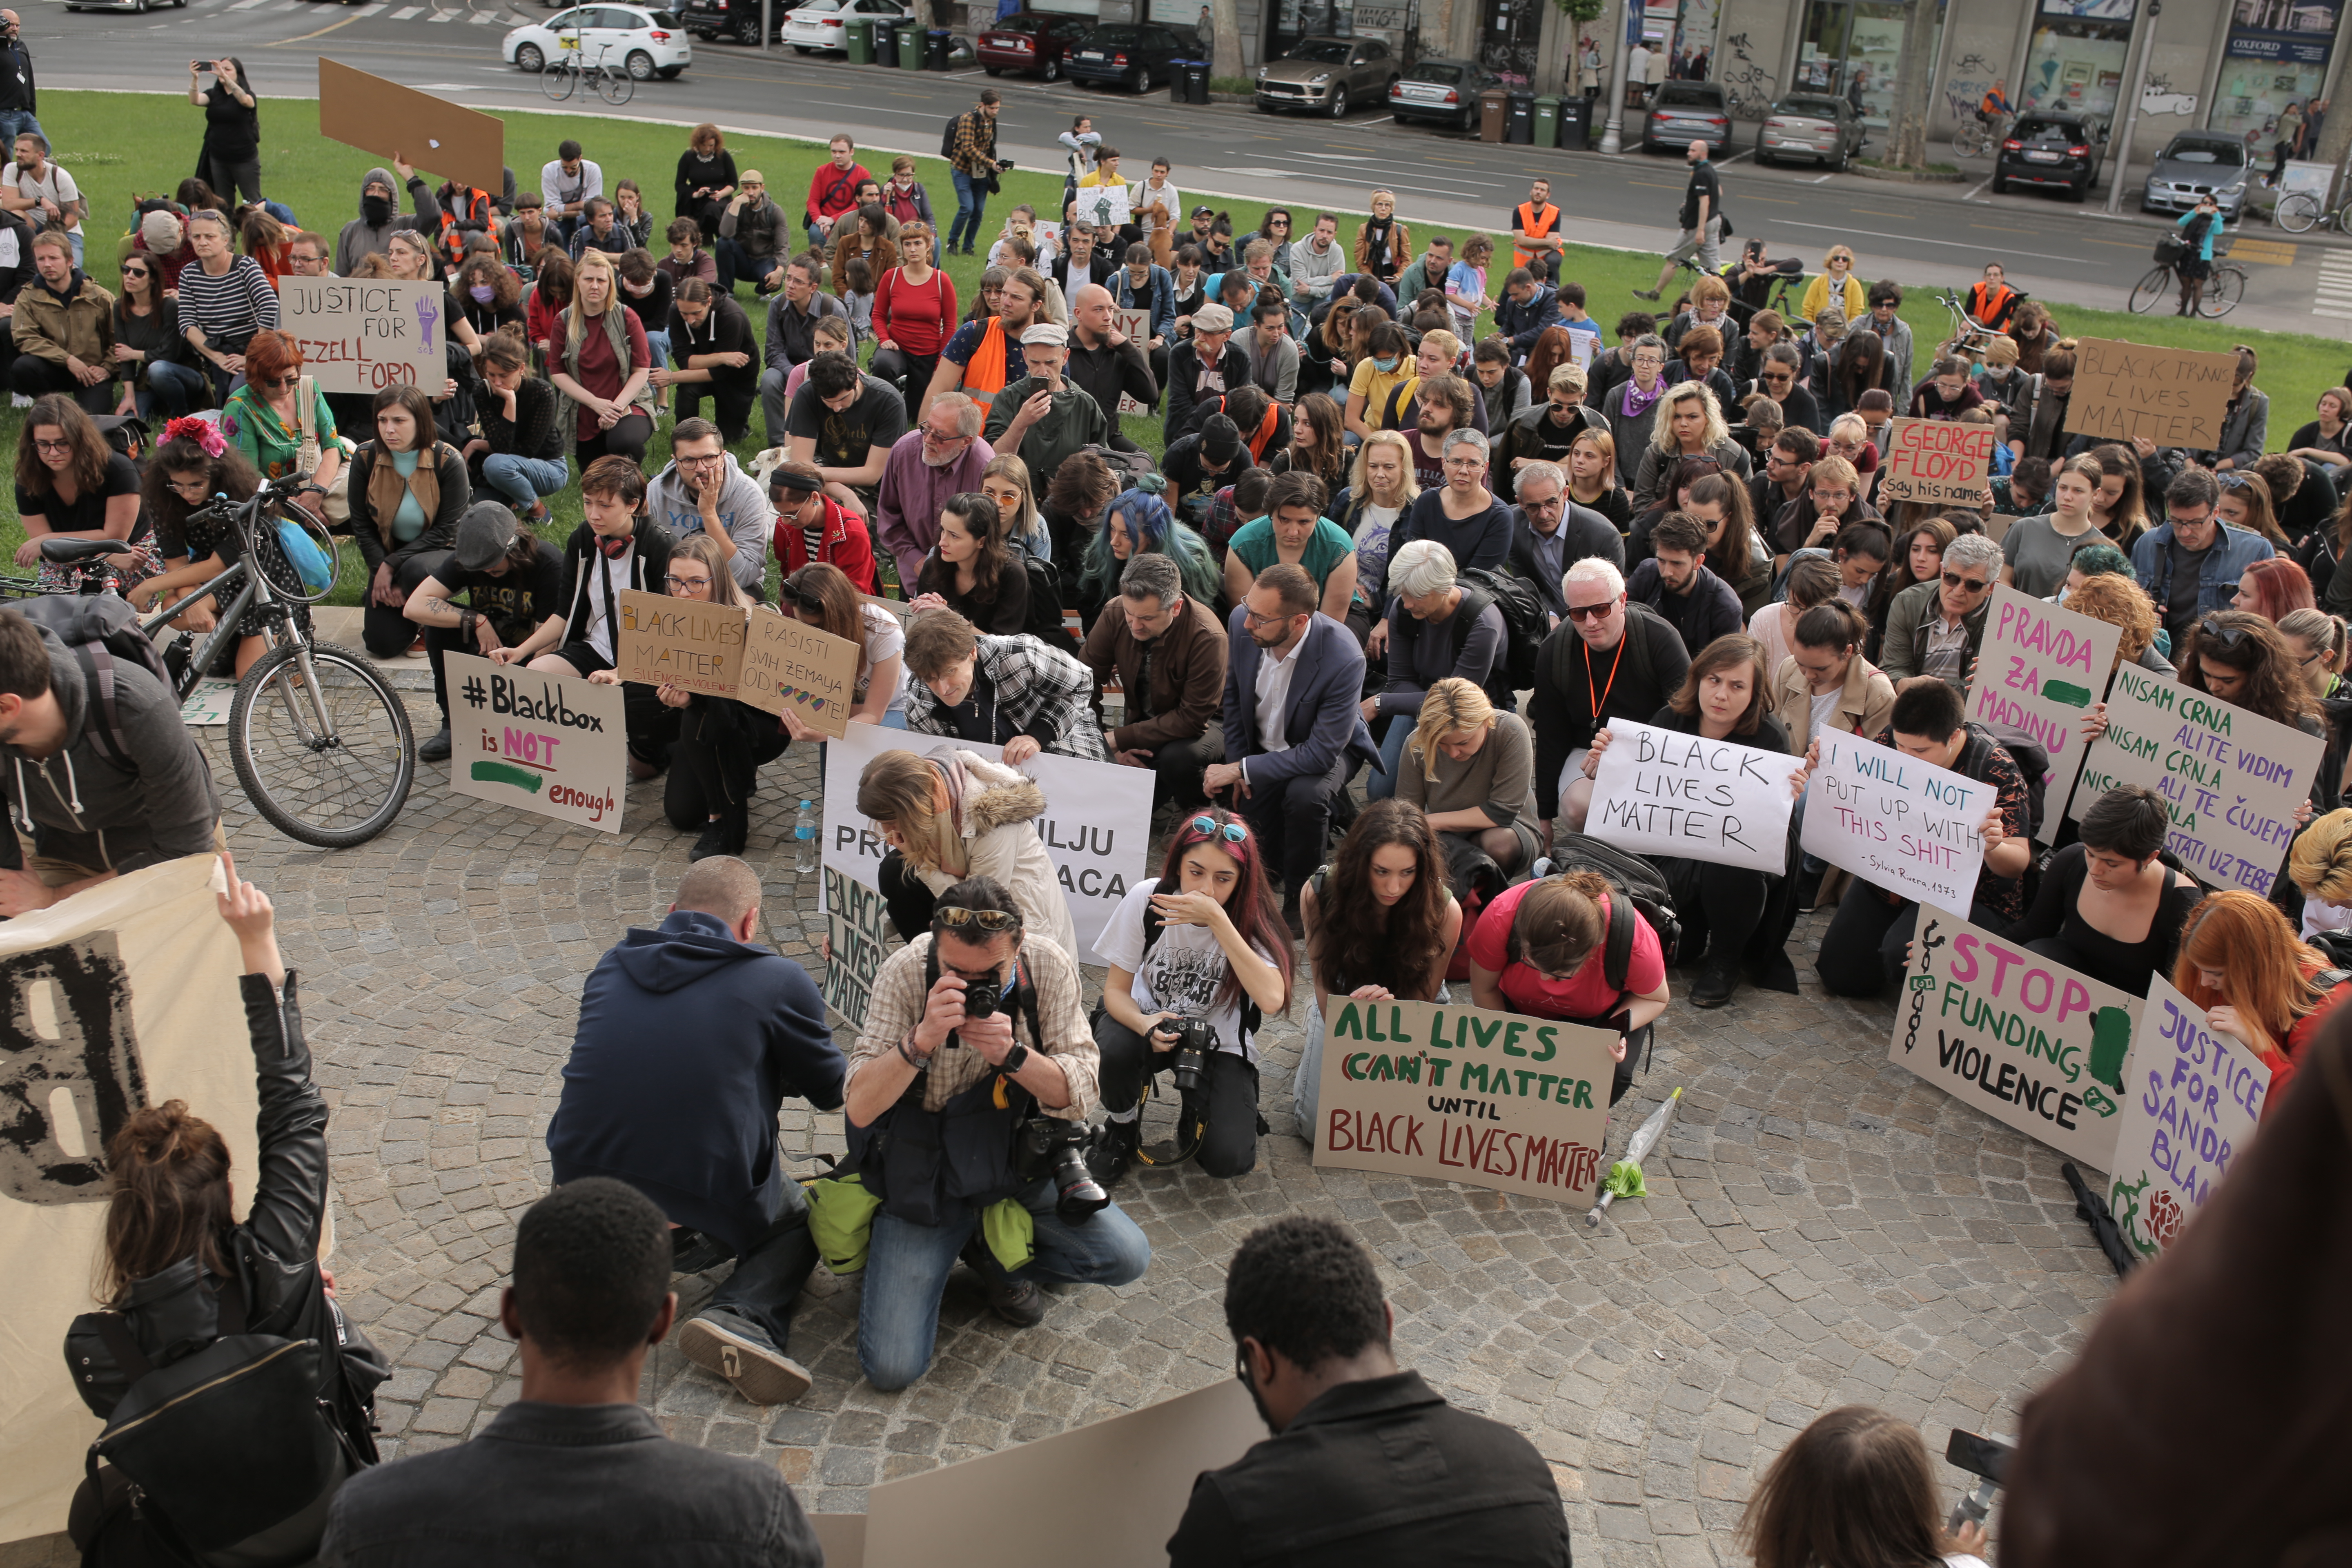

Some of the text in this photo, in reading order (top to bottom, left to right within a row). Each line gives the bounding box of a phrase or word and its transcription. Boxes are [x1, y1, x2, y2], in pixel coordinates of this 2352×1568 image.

[2233, 39, 2281, 51] OXFORD
[1078, 209, 1095, 220] BLM
[293, 286, 401, 315] JUSTICE
[365, 317, 405, 338] FOR
[298, 336, 372, 363] EZELL
[357, 362, 416, 389] FORD
[2083, 347, 2229, 382] BLACK TRANS
[2107, 381, 2190, 408] LIVES
[1902, 423, 1994, 461] GEORGE
[2080, 404, 2211, 442] MATTER
[1886, 478, 1982, 501] Say his name
[1892, 450, 1976, 481] FLOYD
[192, 611, 231, 670] BICYCLE
[623, 605, 741, 645] BLACK LIVES
[764, 622, 829, 659] RASISTI
[1997, 602, 2092, 673] PRAVDA
[636, 645, 723, 676] MATTER
[745, 667, 770, 691] OD
[749, 646, 779, 671] SVIH
[2004, 655, 2038, 696] ZA
[461, 674, 604, 733] #Blackbox
[1977, 685, 2067, 754] MADINU
[2118, 671, 2231, 737] NISAM CRNA
[481, 726, 561, 766] is NOT
[1635, 731, 1769, 785] BLACK
[2103, 722, 2221, 791] NISAM CRNA
[2173, 724, 2294, 789] ALI TE VIDIM
[549, 785, 615, 822] enough
[1635, 771, 1734, 806] LIVES
[1832, 744, 1973, 811] I WILL NOT
[1603, 797, 1757, 853] MATTER
[1825, 776, 1980, 853] PUT UP WITH
[1834, 806, 1961, 872] THIS SHIT.
[2156, 775, 2292, 851] ALI TE ČUJEM
[1869, 855, 1895, 875] Sylvia
[2164, 831, 2276, 895] STATI UZ TEBE
[824, 864, 887, 945] BLACK
[828, 913, 880, 988] LIVES
[822, 956, 871, 1031] MATTE
[1950, 933, 2091, 1023] STOP
[1334, 1002, 1559, 1062] ALL LIVES
[1941, 981, 2082, 1085] FUNDING
[1341, 1050, 1594, 1110] CAN'T MATTER
[1938, 1029, 2083, 1131] VIOLENCE
[2159, 999, 2264, 1123] JUSTICE
[1428, 1095, 1501, 1121] UNTIL
[2171, 1056, 2218, 1124] FOR
[1137, 1149, 1155, 1165] Nikon
[1329, 1108, 1599, 1192] BLACK LIVES MATTER
